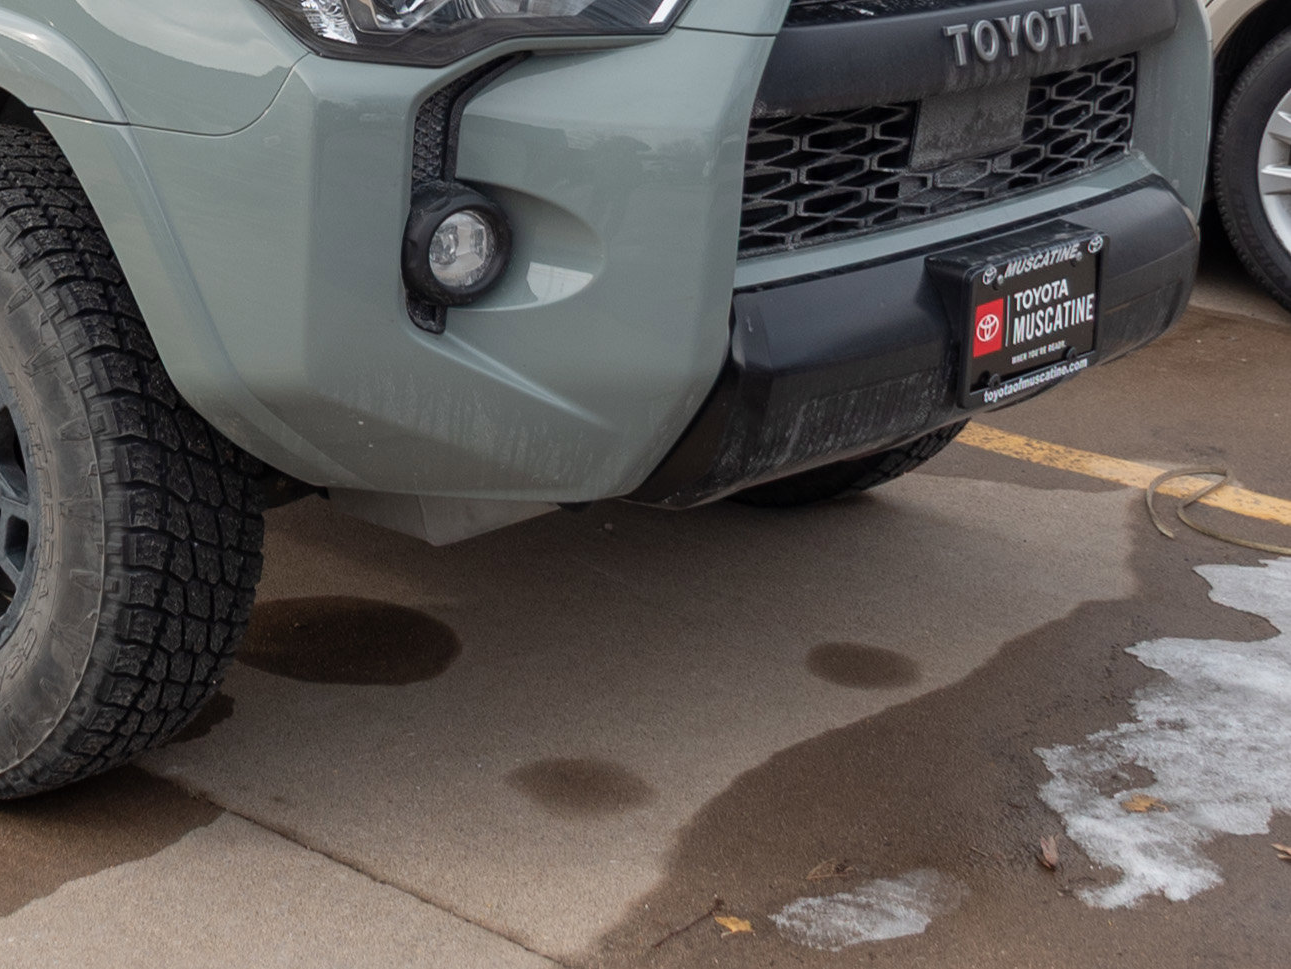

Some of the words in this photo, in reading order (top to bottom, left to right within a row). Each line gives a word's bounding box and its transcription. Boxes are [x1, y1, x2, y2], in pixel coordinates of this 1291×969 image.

[943, 3, 1093, 66] TOYOTA
[1004, 243, 1080, 279] MUSCATINE
[1014, 278, 1068, 312] TOYOTA
[1012, 293, 1094, 345] MUSCATINE
[984, 358, 1088, 403] toyotaofmuscatine.com
